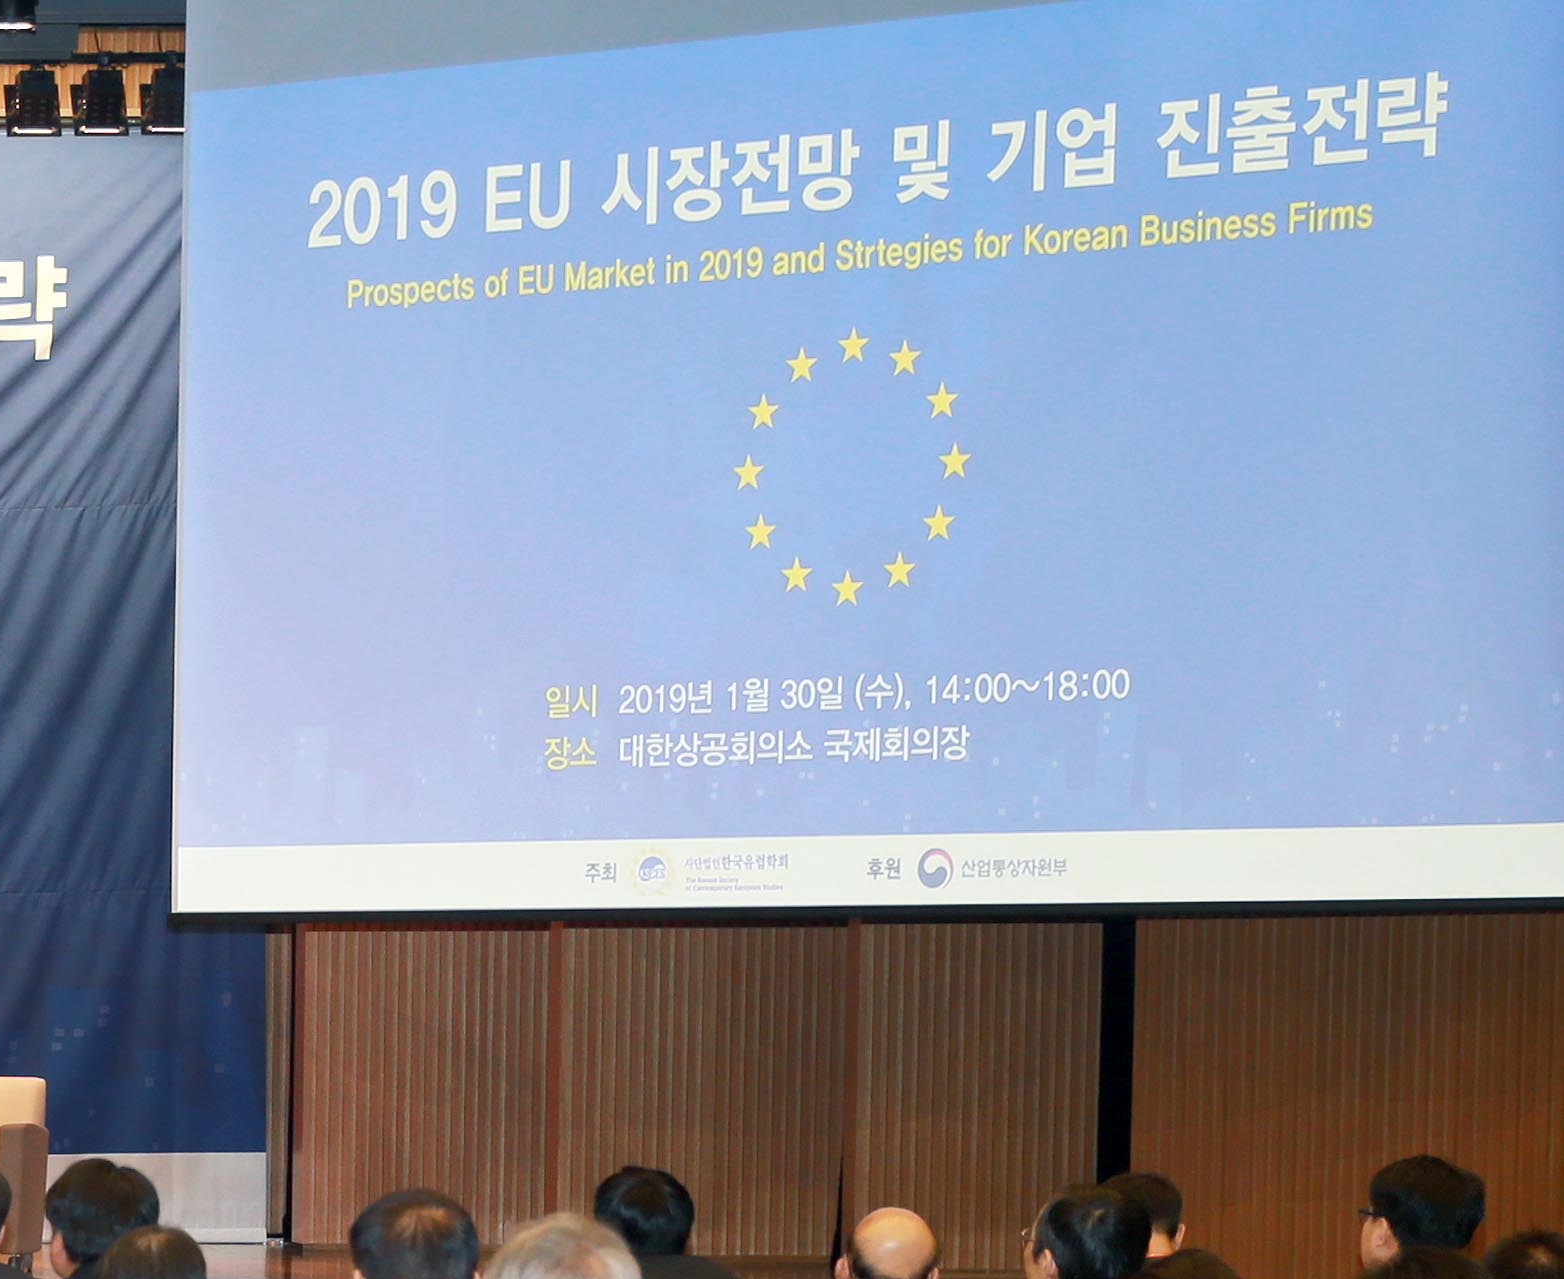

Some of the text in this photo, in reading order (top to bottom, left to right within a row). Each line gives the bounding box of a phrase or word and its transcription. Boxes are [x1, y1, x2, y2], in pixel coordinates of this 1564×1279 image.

[307, 69, 1450, 249] 2019 EU 시장전망 및 기업 진출전략
[347, 200, 1375, 308] Prospects of EU Market in 2019 and Strtegies for Korean Business Firms
[544, 685, 599, 719] 일시
[619, 679, 712, 714] 2019년
[727, 677, 769, 712] 1월
[780, 675, 843, 710] 30일
[855, 672, 911, 711] (수),
[544, 724, 971, 772] 장소 대한상공회의소 국제회의장
[584, 862, 617, 884] 주최
[866, 857, 901, 881] 후원
